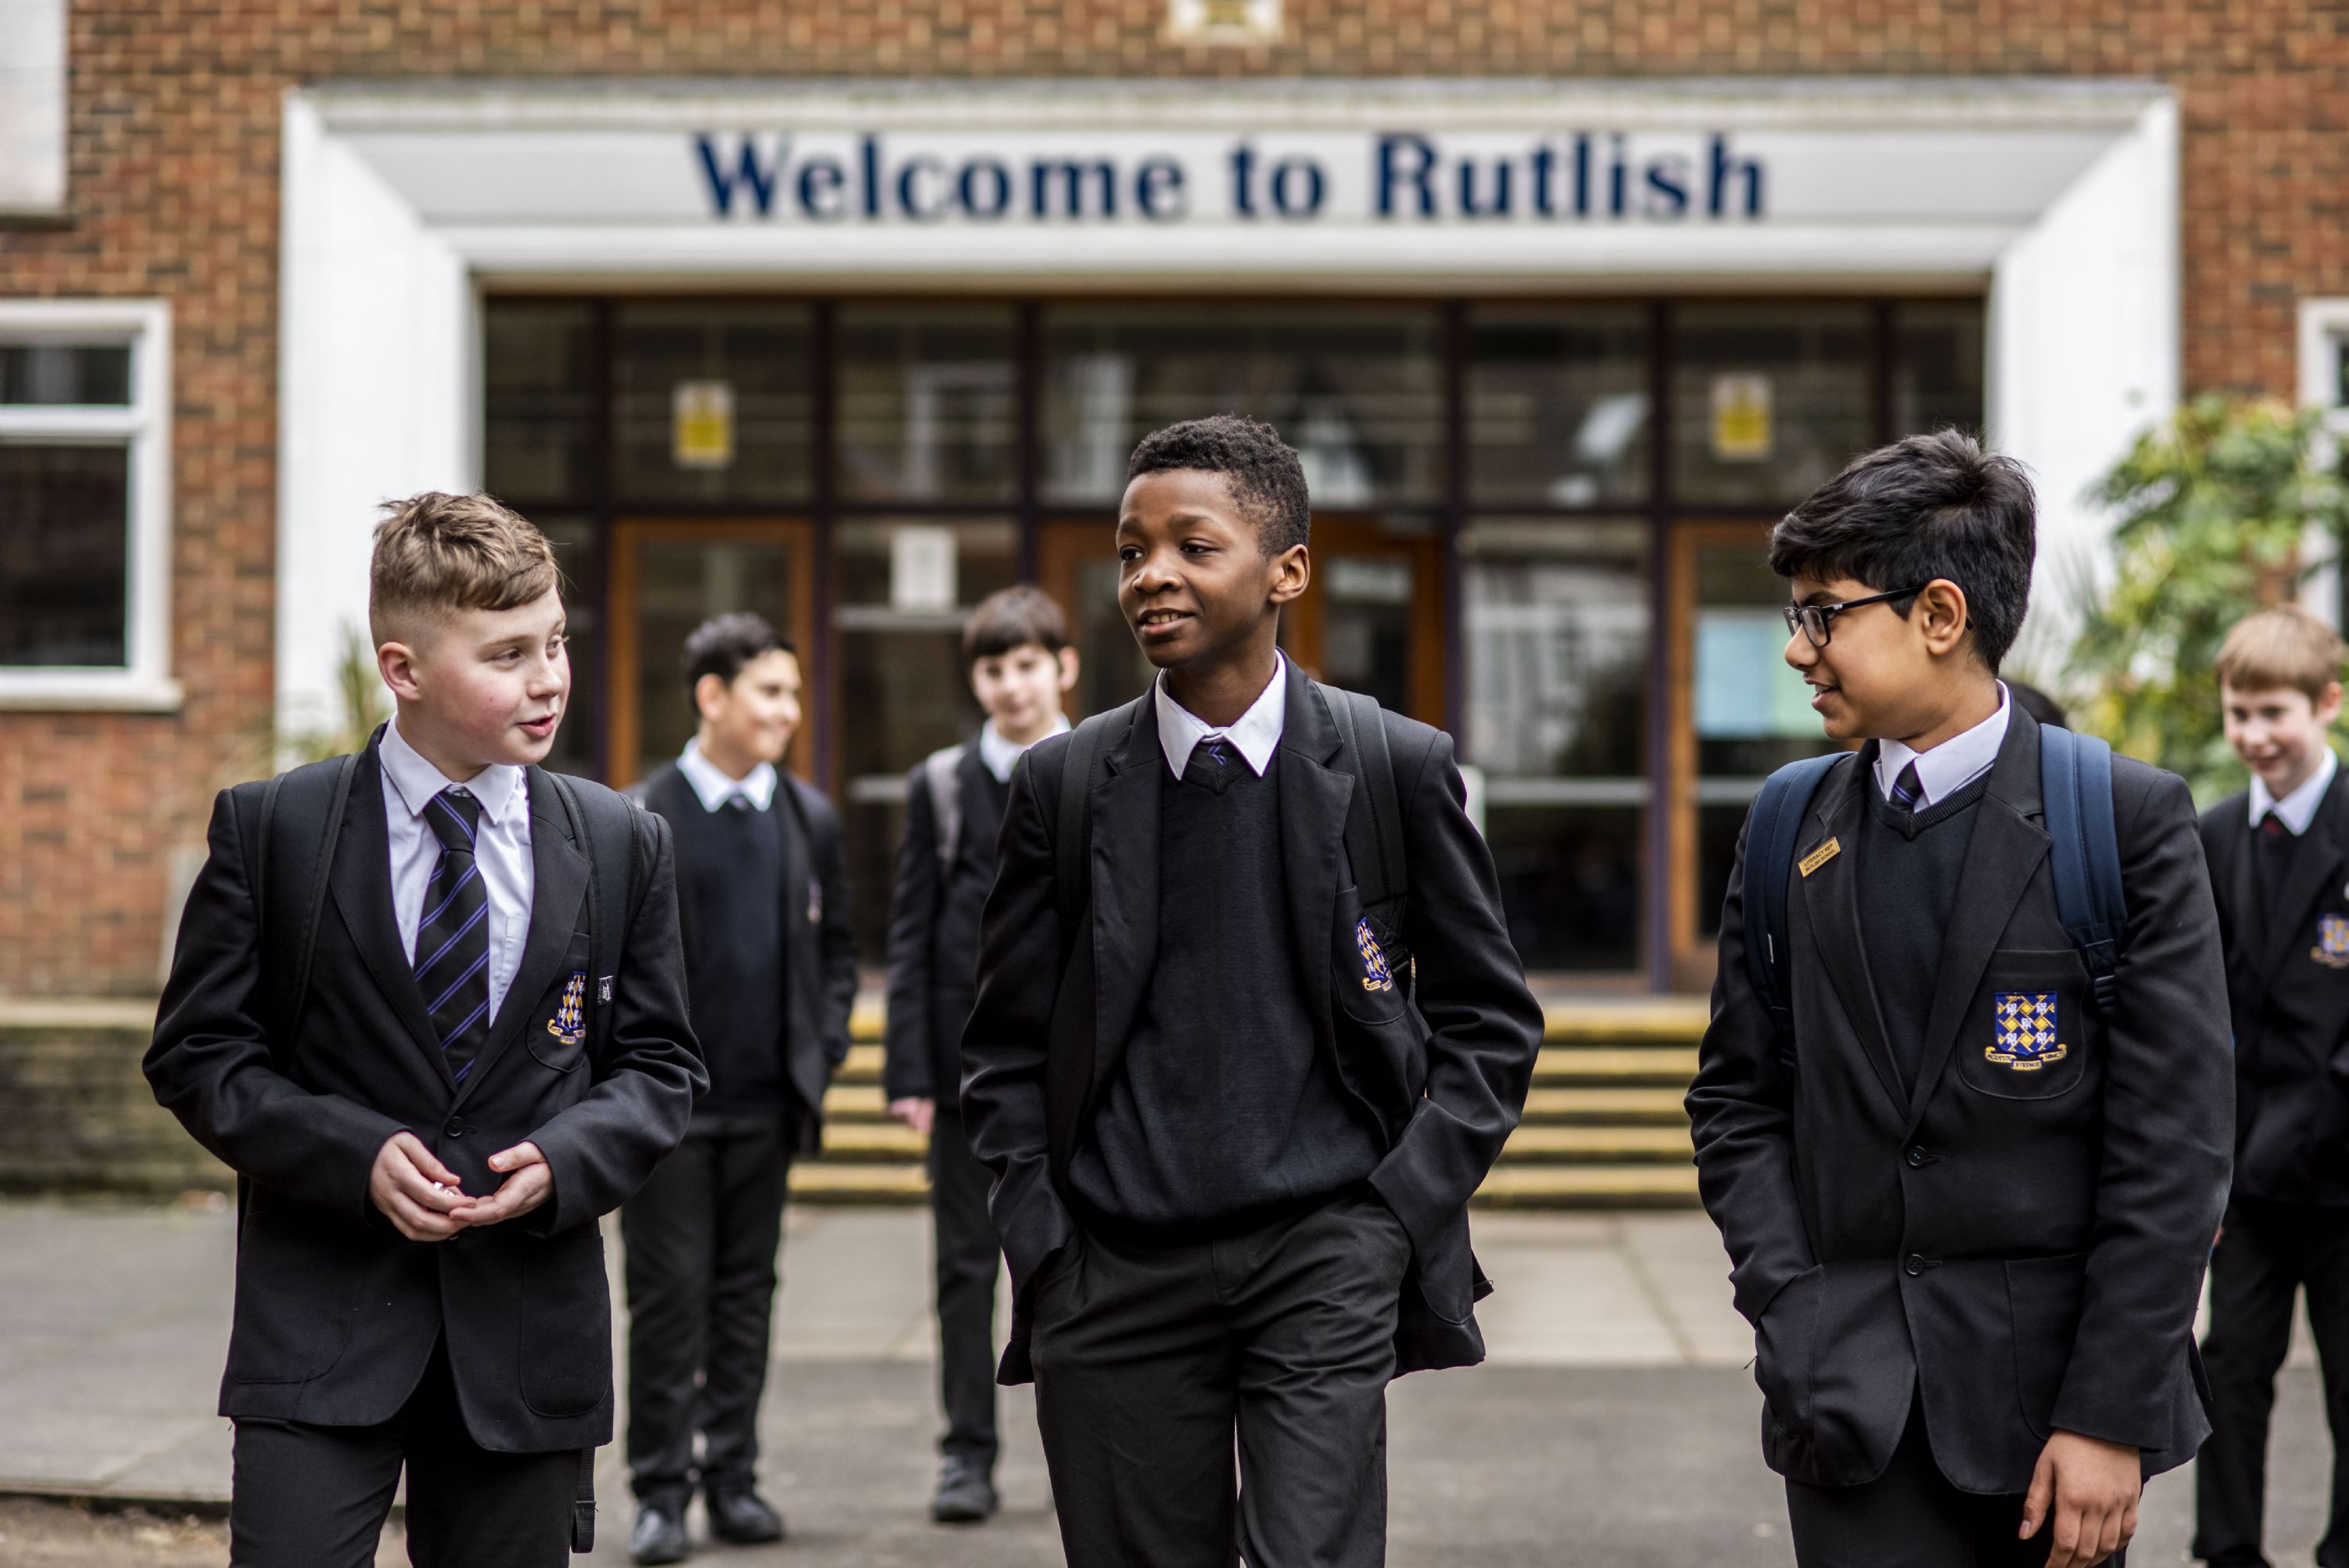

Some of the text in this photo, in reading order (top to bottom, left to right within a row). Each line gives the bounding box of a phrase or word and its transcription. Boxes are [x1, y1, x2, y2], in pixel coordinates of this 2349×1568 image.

[693, 133, 1763, 220] Welcome to Rutlish
[1804, 851, 1824, 867] LITERACY
